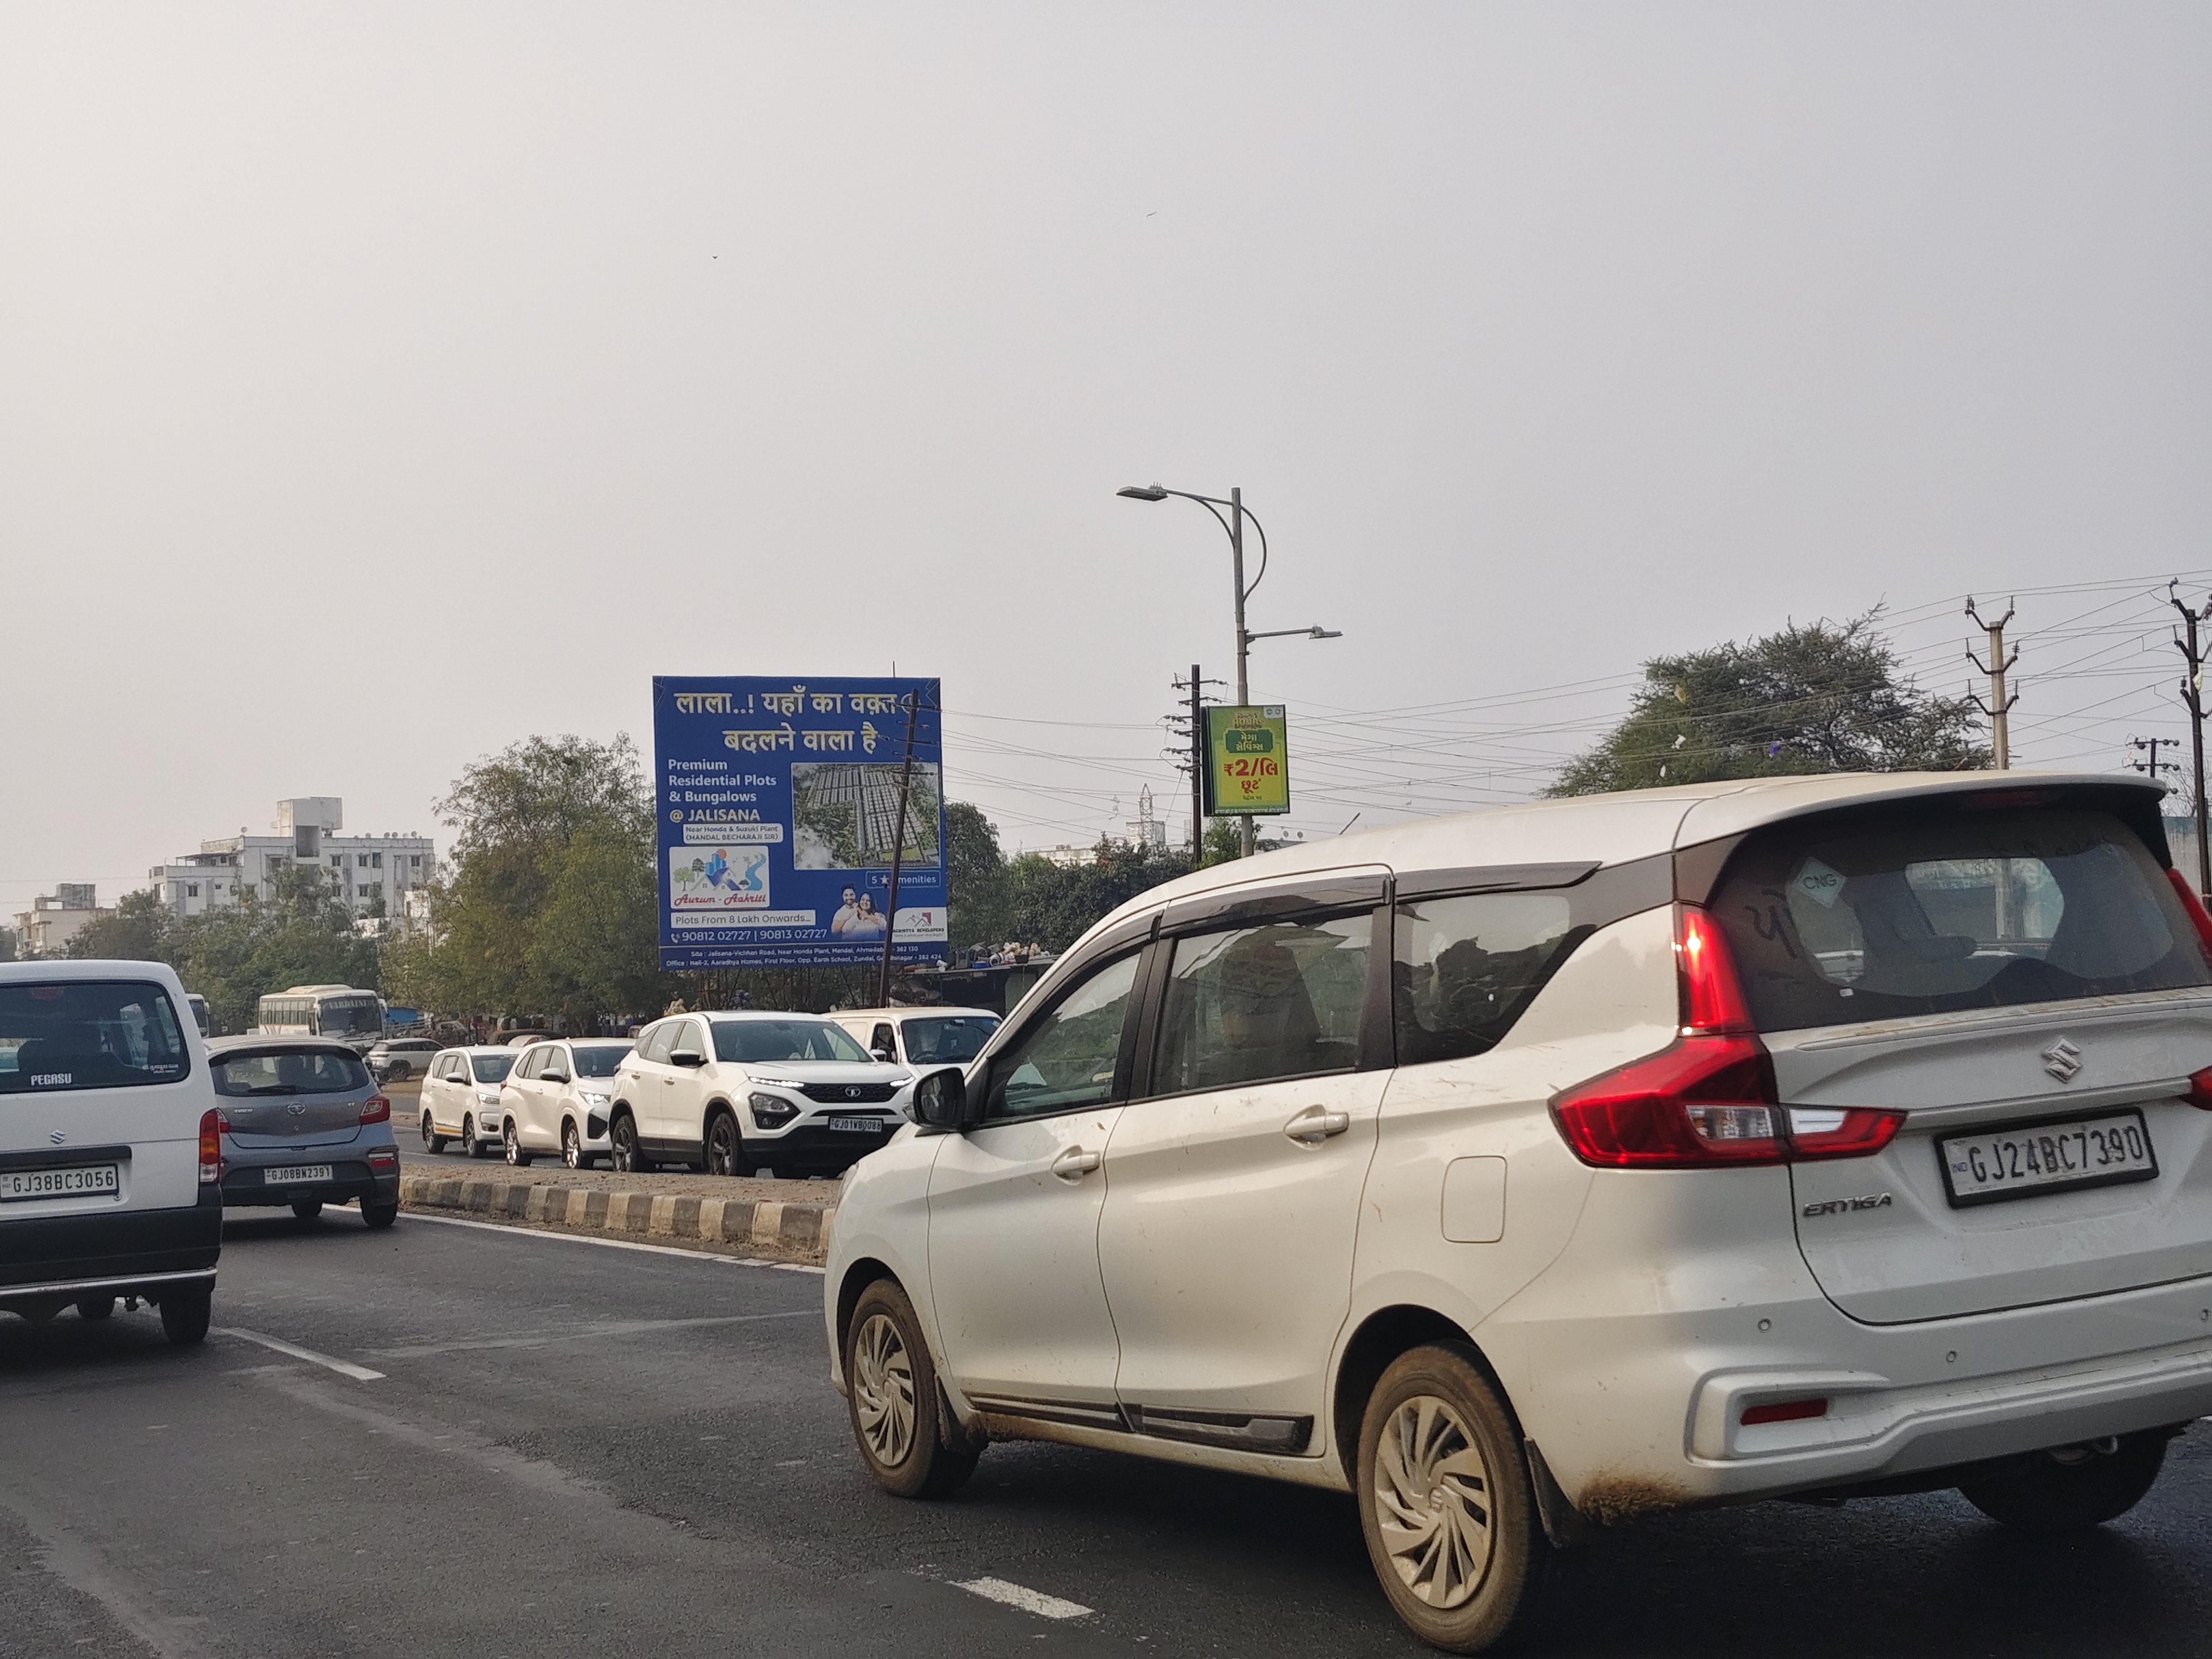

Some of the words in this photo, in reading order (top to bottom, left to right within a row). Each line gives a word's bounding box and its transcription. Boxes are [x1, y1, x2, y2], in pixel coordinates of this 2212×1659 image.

[761, 684, 805, 717] यहाँ
[810, 693, 843, 714] का
[721, 721, 796, 754] बदलने
[801, 730, 854, 752] वाला
[861, 721, 879, 754] है
[668, 758, 728, 771] Premium
[669, 774, 740, 786] Residential
[744, 774, 777, 786] Plots
[669, 791, 682, 802] &
[685, 790, 757, 805] Bungalows
[669, 809, 684, 824] @
[687, 808, 761, 822] JALISANA
[871, 875, 878, 884] 5
[898, 875, 936, 884] menities
[1803, 873, 1837, 889] CNG
[674, 894, 716, 906] Aurum
[724, 893, 766, 905] Aakriti
[676, 916, 699, 925] Plots
[702, 916, 726, 924] From
[729, 915, 735, 923] 8
[738, 915, 760, 923] Lakh
[682, 931, 716, 941] 90812
[717, 930, 751, 940] 02727
[759, 929, 792, 940] 90813
[794, 929, 827, 939] 02727
[31, 1073, 72, 1086] PEGASU
[1968, 1125, 2143, 1182] GJ24BC7390
[14, 1171, 113, 1192] GJ38BC3056
[1803, 1191, 1892, 1217] ERTIGA
